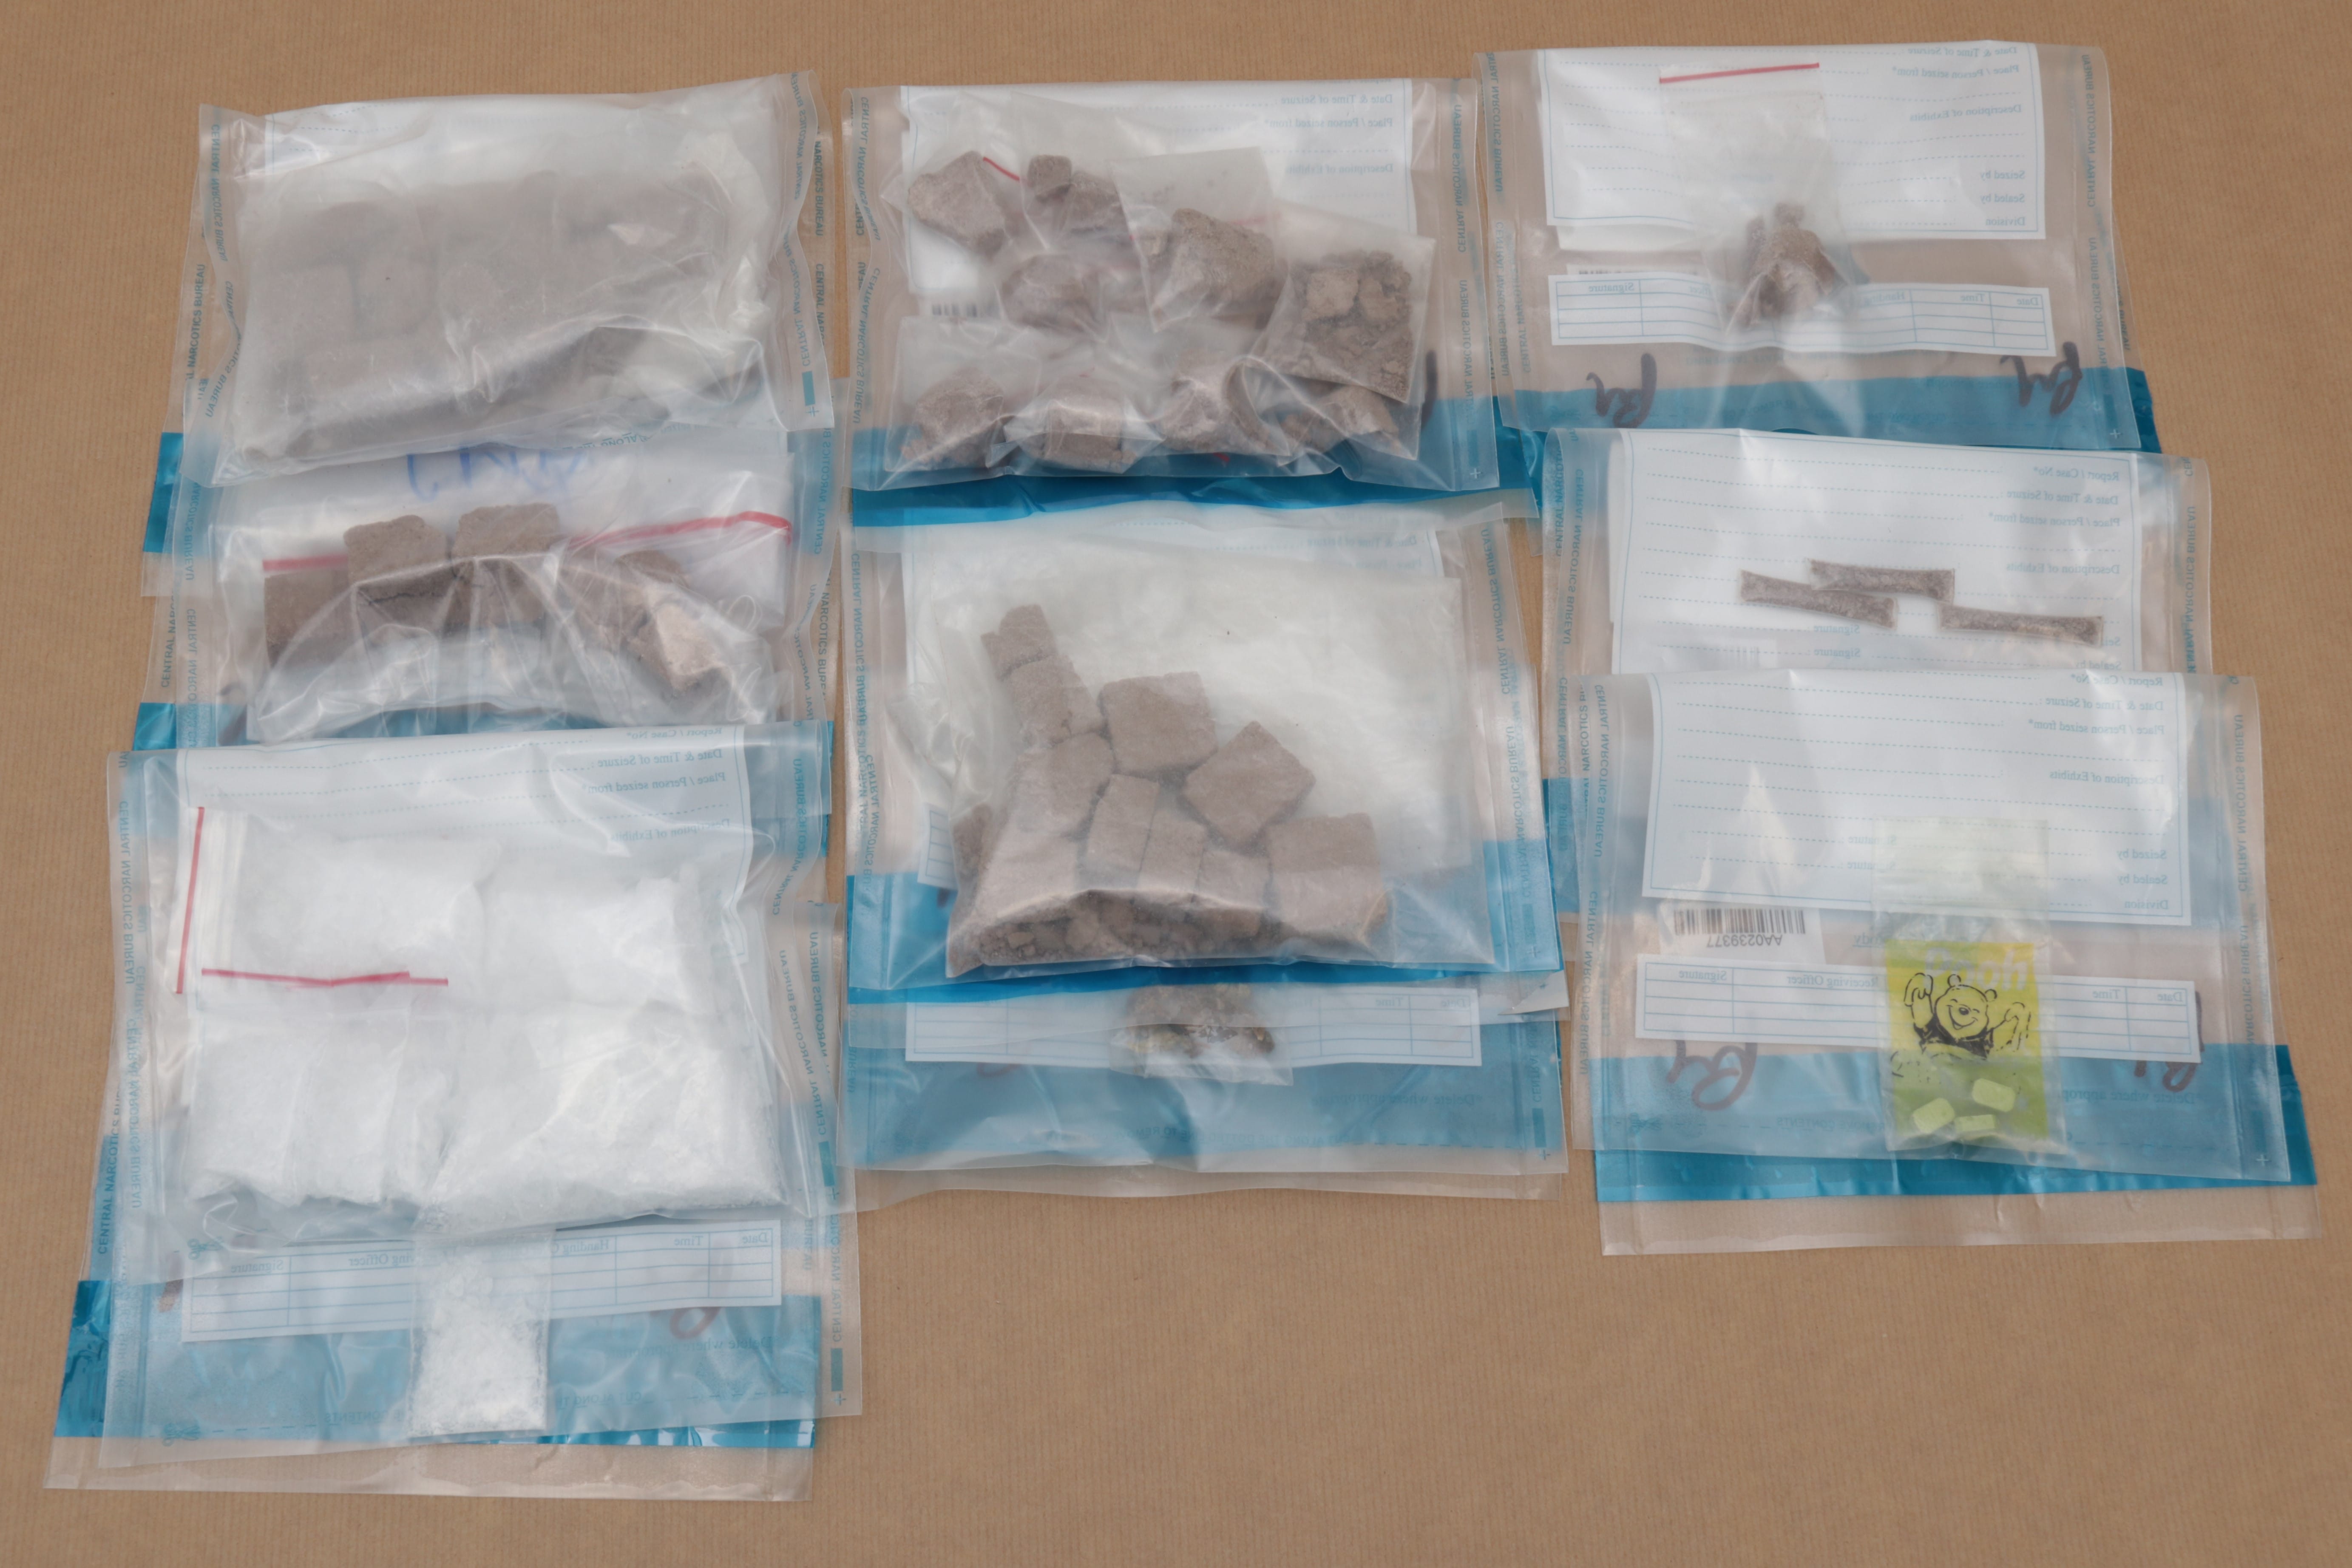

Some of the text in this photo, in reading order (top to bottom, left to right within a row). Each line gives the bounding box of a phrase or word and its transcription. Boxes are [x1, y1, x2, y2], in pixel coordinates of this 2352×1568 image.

[161, 635, 175, 688] CENTRAL
[1706, 934, 1782, 947] AA0239377
[1924, 948, 2028, 992] Pooh
[97, 1196, 113, 1254] CENTRAL
